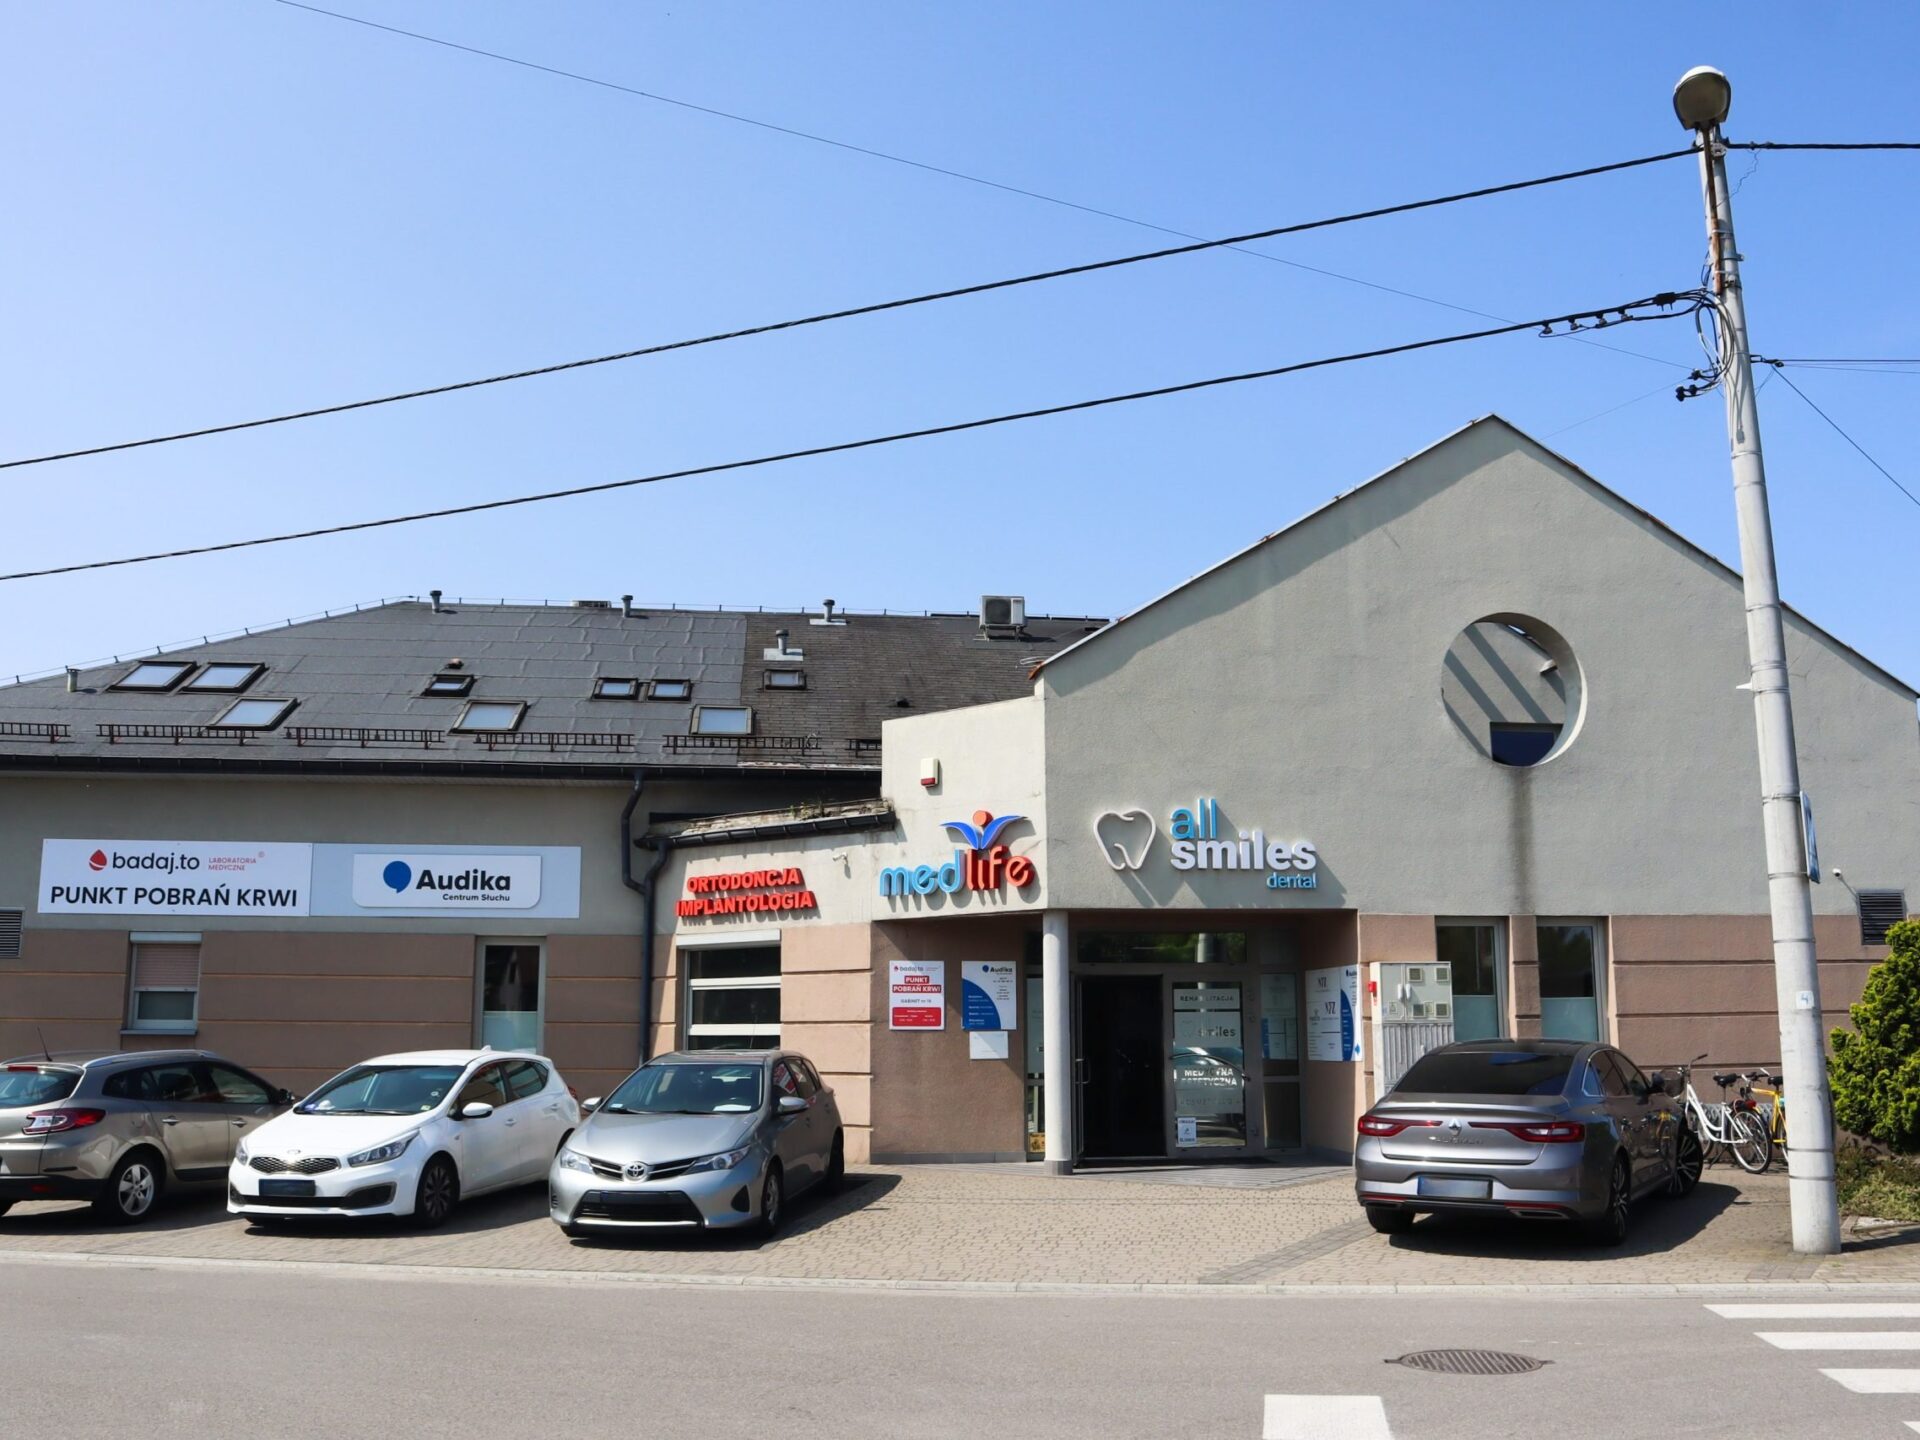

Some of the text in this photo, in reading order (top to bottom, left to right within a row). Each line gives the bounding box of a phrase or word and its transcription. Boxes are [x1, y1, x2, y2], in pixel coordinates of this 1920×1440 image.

[1170, 797, 1217, 840] all
[1170, 829, 1317, 870] smiles
[112, 852, 200, 874] badaj.to
[416, 868, 511, 891] Audika
[687, 867, 803, 894] ORTODONCJA
[1266, 871, 1317, 889] dental
[50, 883, 297, 907] PUNKT POBRAŃ KRWI
[442, 893, 510, 902] Centrum Słuchu
[675, 890, 815, 917] IMPLANTOLOGIA
